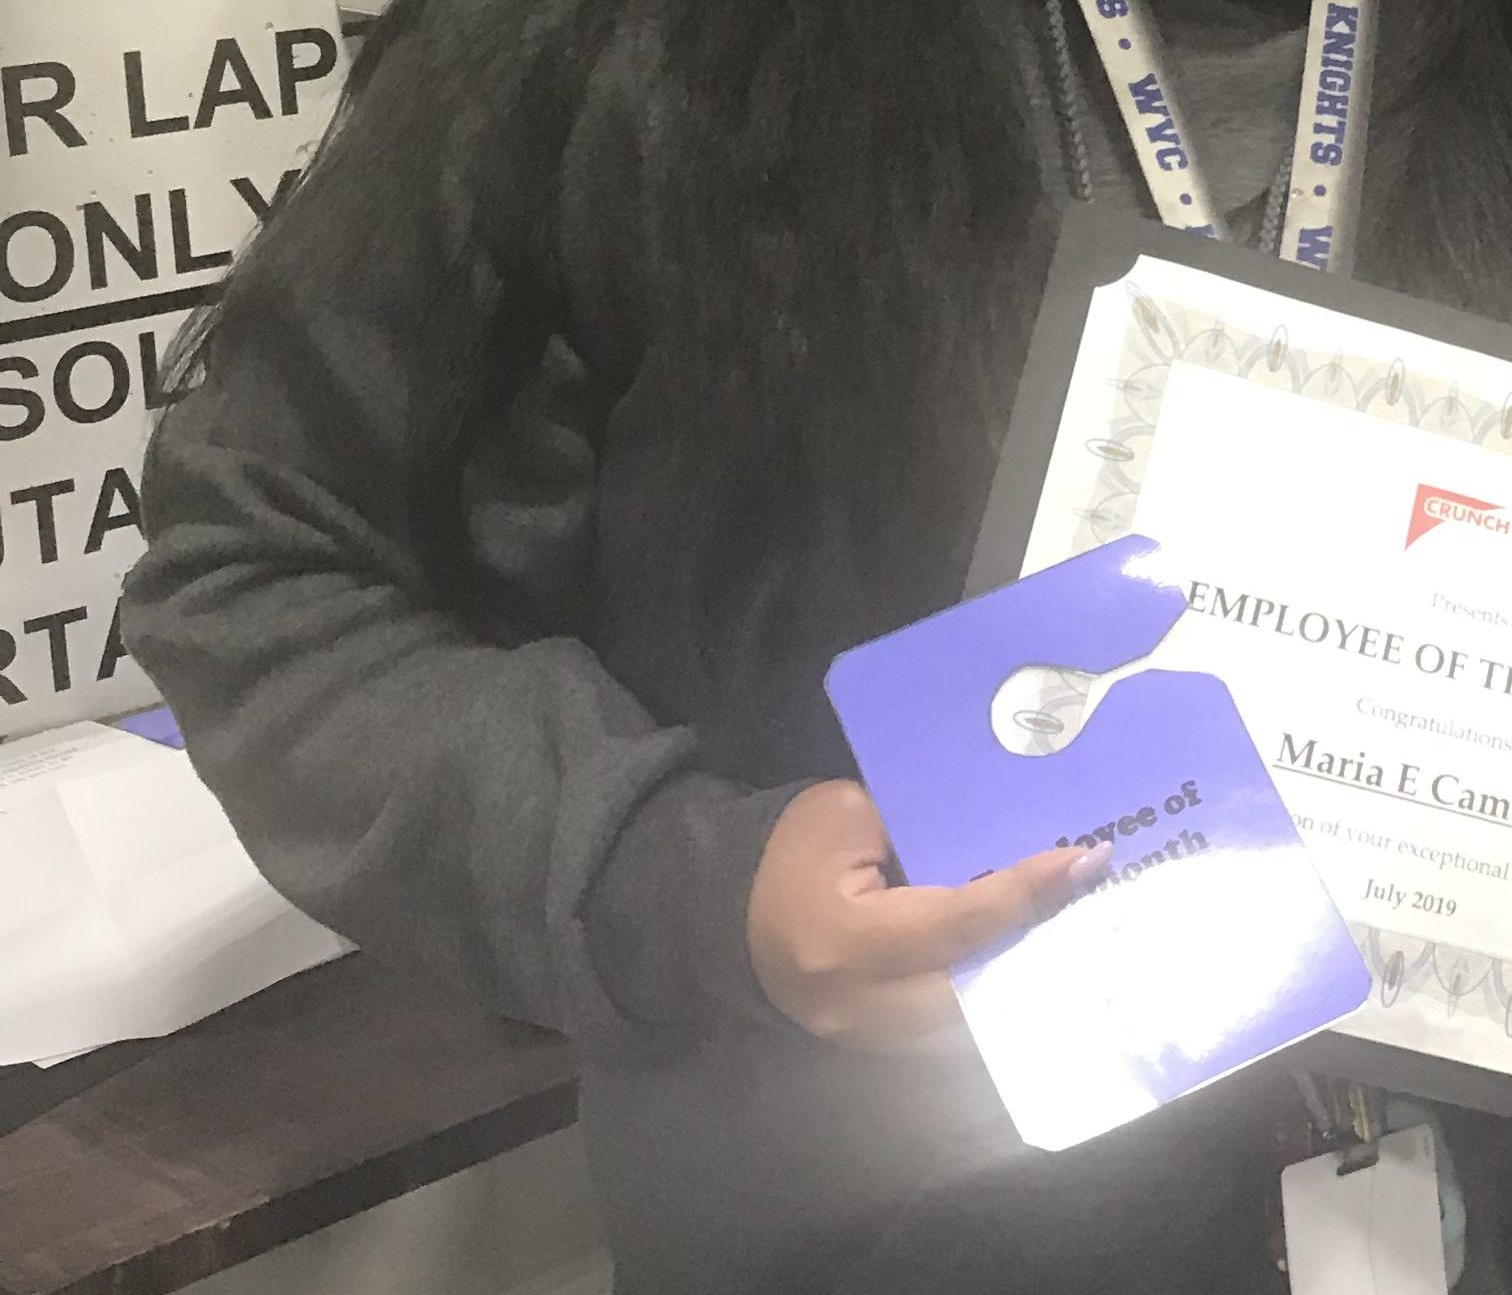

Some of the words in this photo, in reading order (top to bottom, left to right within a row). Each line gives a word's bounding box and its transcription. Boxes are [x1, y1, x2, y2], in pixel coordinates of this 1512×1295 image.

[1310, 2, 1360, 167] KNIGHTS
[1127, 72, 1189, 172] WVC
[1427, 499, 1511, 535] CRUNCH
[1187, 580, 1405, 666] EMPLOYEE
[1414, 642, 1469, 682] OF
[1431, 592, 1509, 626] Presents
[1355, 696, 1512, 755] Congratulations
[1275, 731, 1385, 788] Maria
[1396, 763, 1419, 798] E
[1163, 780, 1202, 815] of
[1090, 828, 1210, 893] onth
[1319, 817, 1340, 836] of
[1345, 826, 1394, 850] your
[1397, 837, 1510, 881] exceptional
[1361, 877, 1408, 911] July
[1410, 891, 1458, 918] 2019
